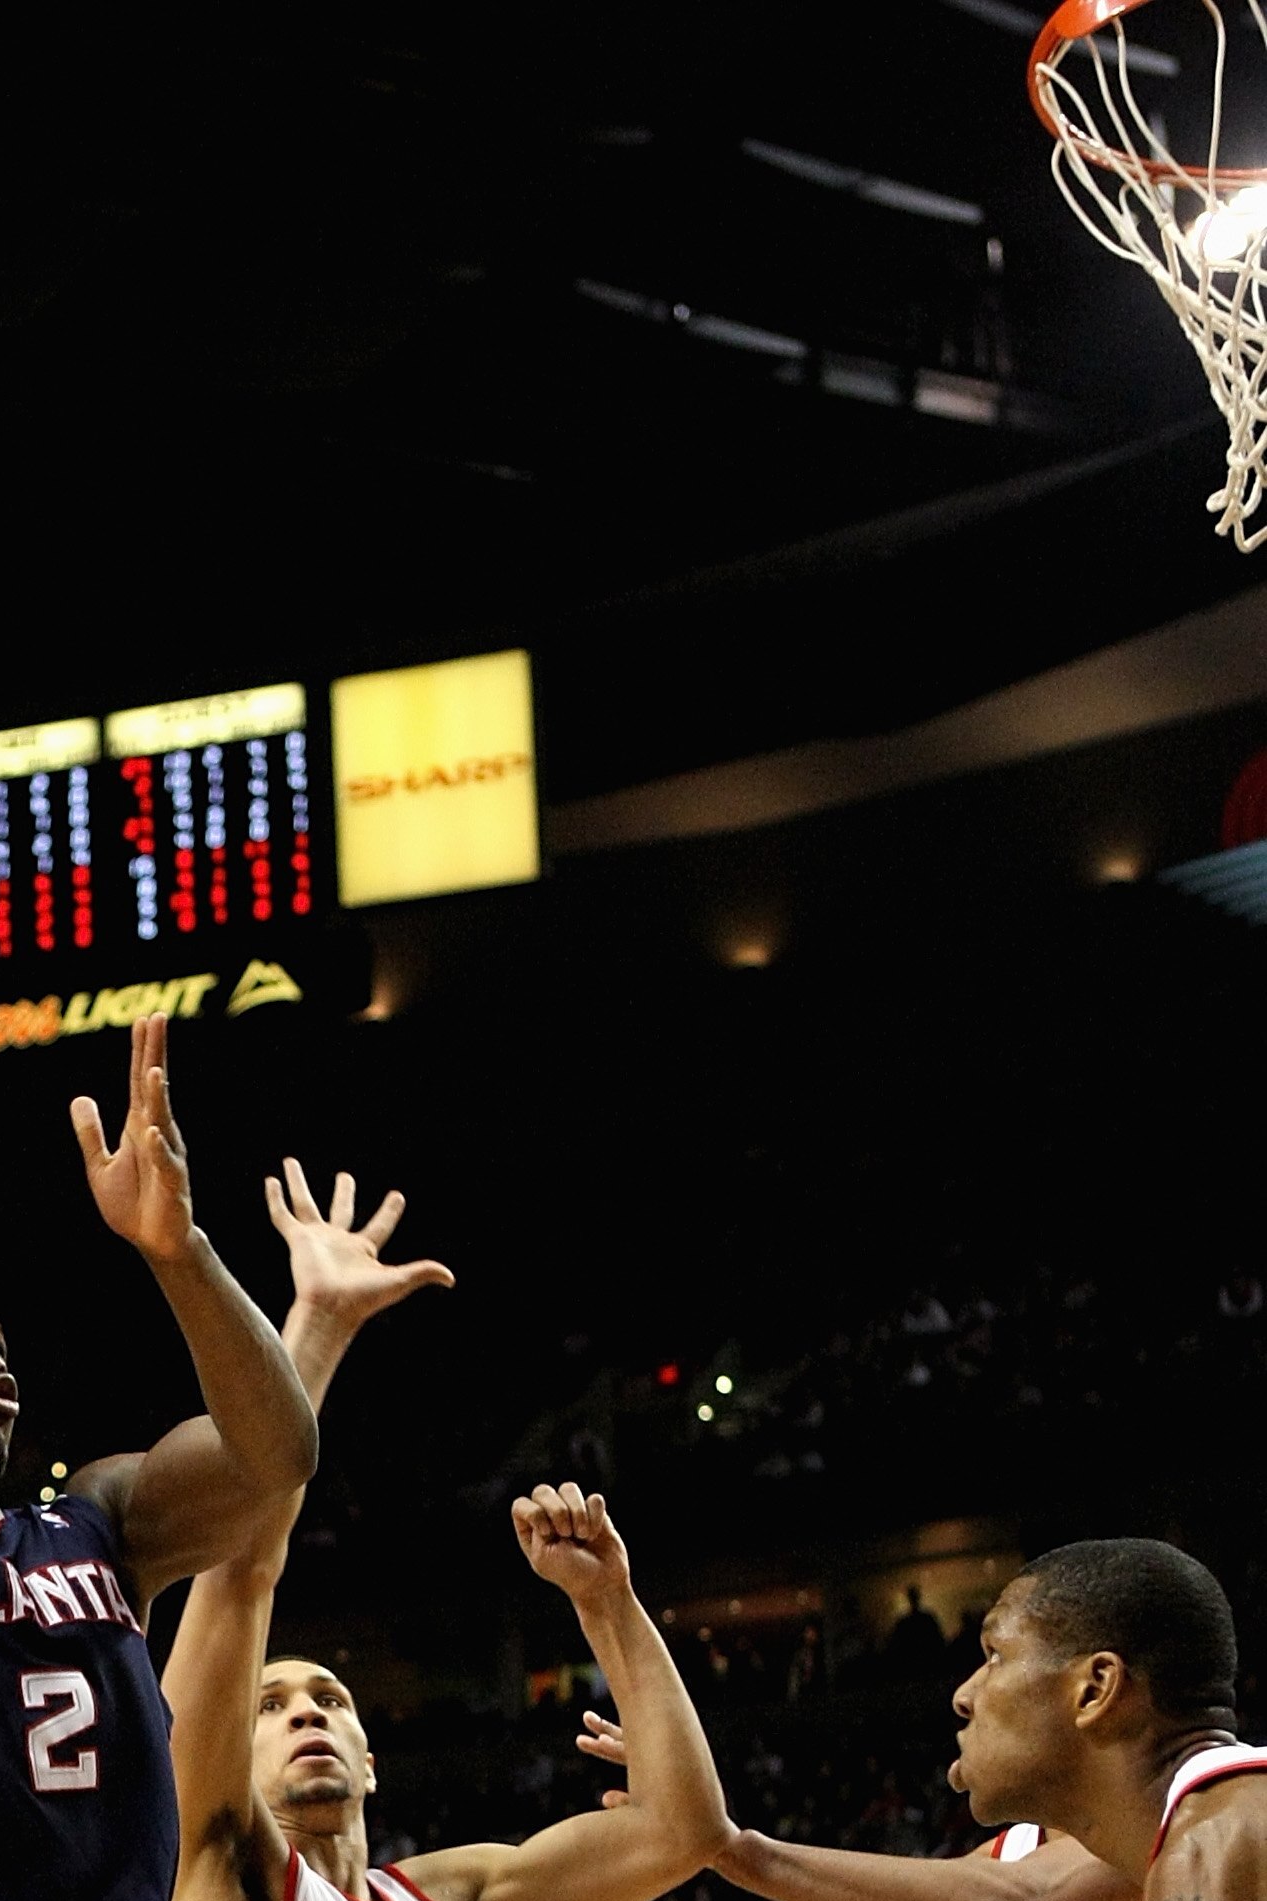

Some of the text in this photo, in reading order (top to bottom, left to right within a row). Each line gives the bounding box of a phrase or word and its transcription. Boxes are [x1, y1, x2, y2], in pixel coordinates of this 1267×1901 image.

[345, 751, 530, 804] SHARP
[60, 971, 219, 1036] LIGHT
[20, 1666, 99, 1792] 2
